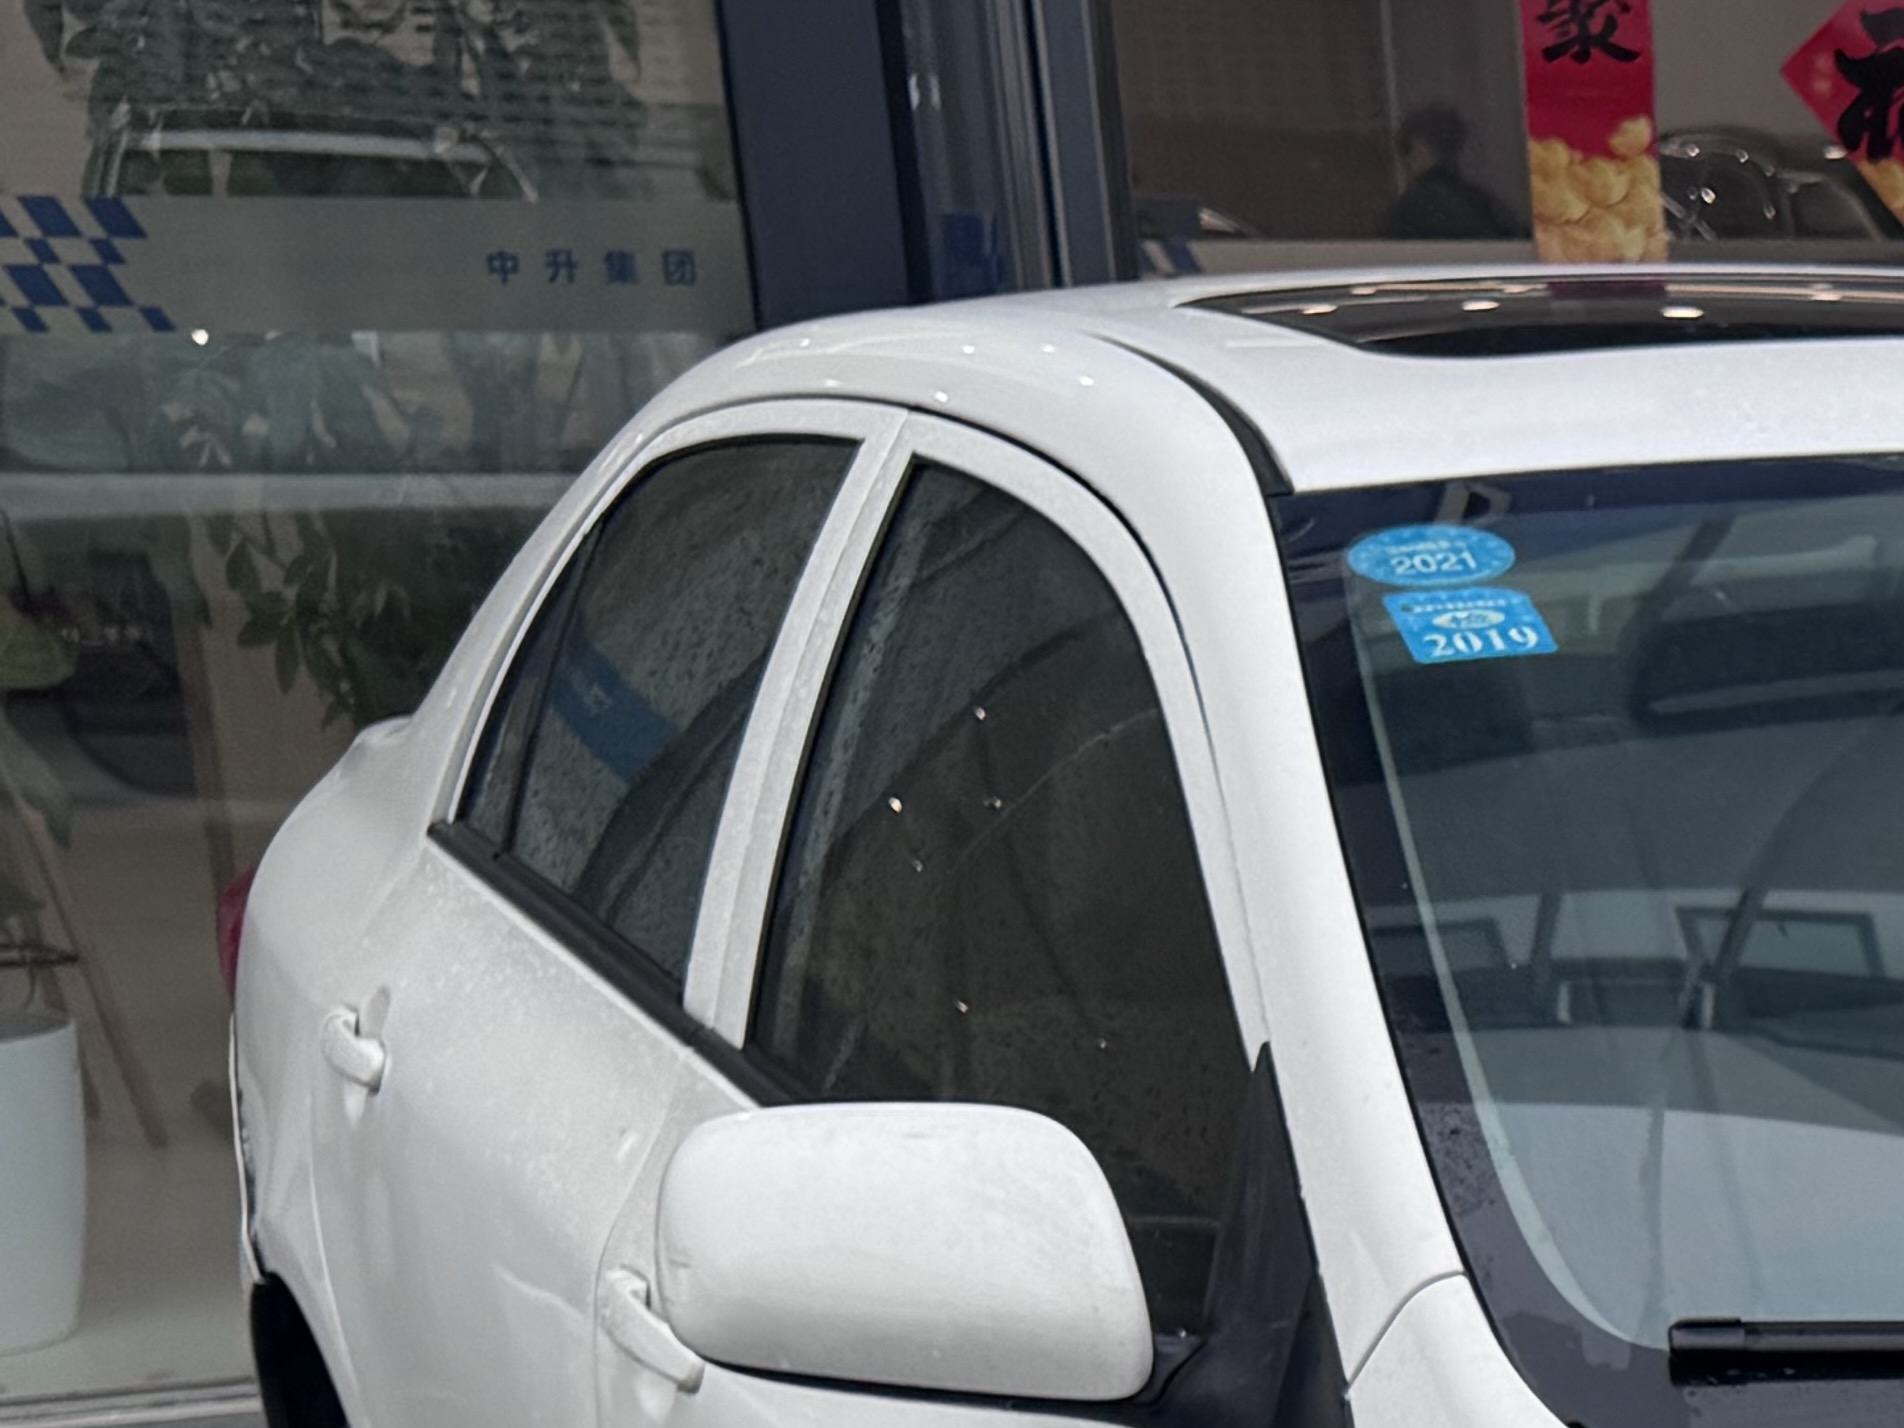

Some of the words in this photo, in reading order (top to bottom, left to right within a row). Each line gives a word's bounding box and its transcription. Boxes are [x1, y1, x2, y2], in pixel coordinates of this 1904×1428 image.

[486, 249, 698, 286] 中升集团
[1392, 552, 1477, 575] 2021
[1424, 625, 1539, 657] 2019
